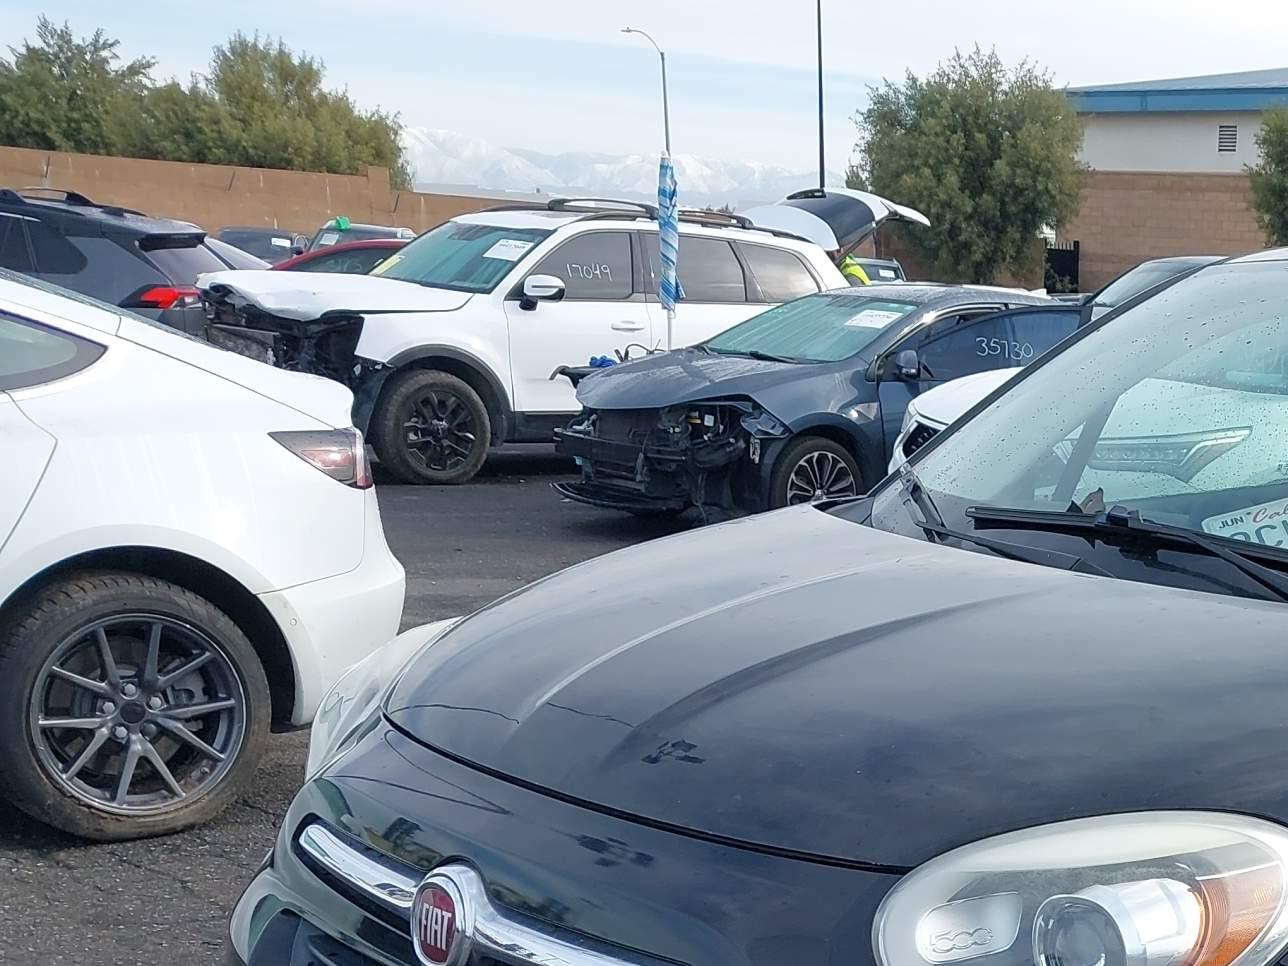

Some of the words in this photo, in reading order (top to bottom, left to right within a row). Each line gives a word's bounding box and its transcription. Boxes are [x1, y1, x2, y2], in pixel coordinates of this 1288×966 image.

[566, 263, 612, 281] 17049
[1218, 516, 1245, 529] JUN
[421, 903, 452, 951] FIAT
